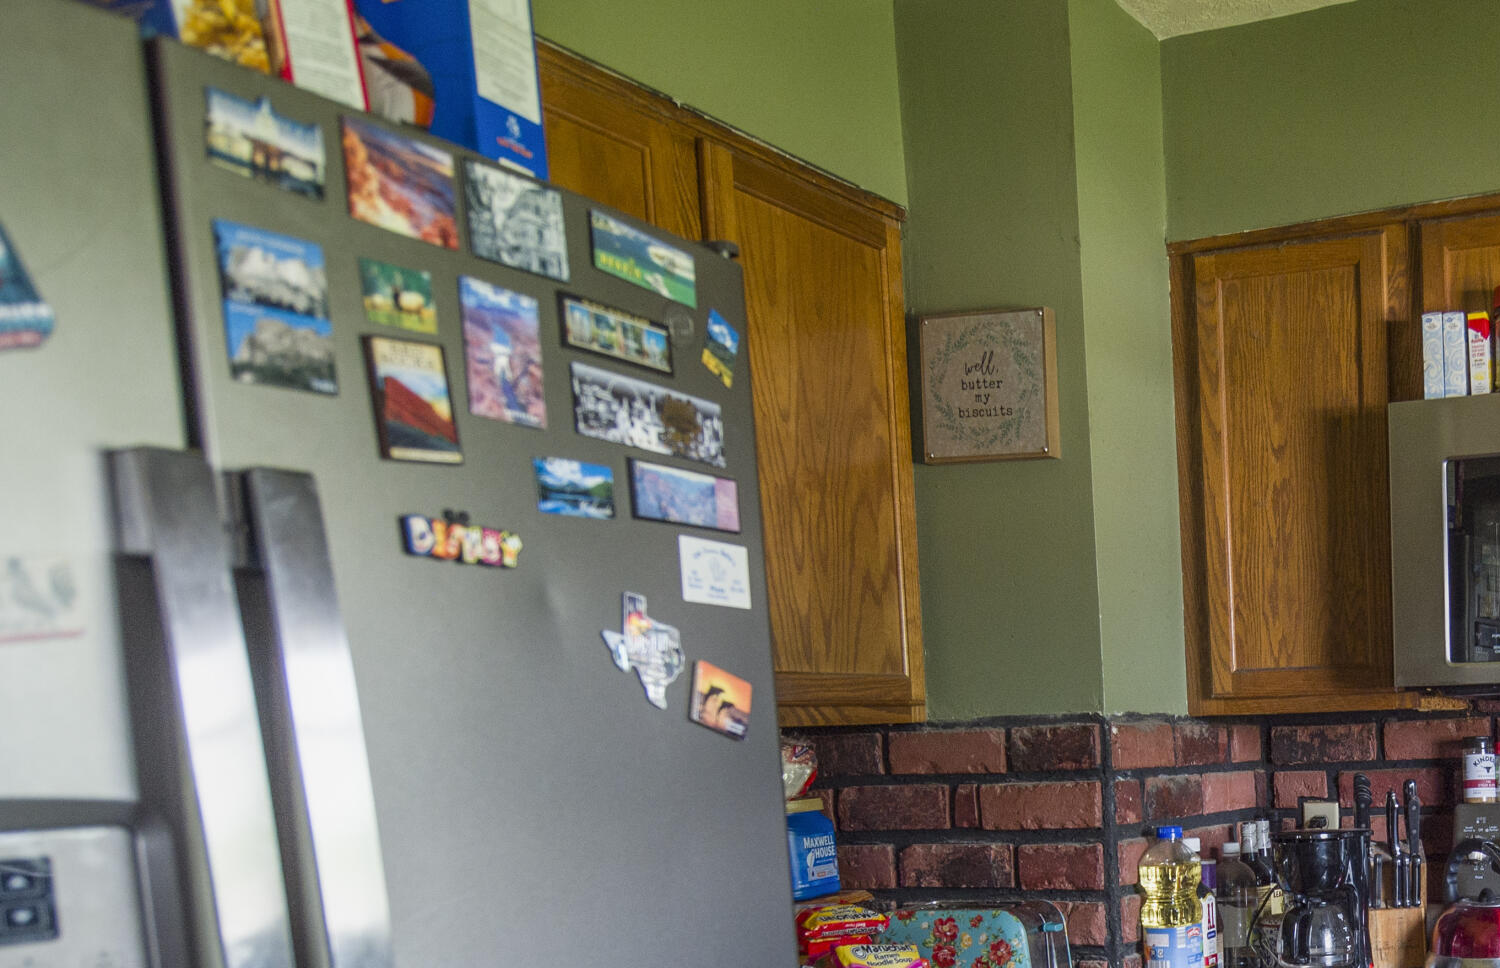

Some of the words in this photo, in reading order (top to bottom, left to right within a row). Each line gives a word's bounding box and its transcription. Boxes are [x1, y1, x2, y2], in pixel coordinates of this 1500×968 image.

[961, 378, 1003, 391] butter
[975, 393, 991, 405] my
[958, 406, 1014, 419] biscuits
[803, 835, 835, 849] MAXWELL
[815, 845, 836, 859] HOUSE
[861, 944, 913, 954] Maruchan
[867, 958, 894, 966] Noodle
[895, 957, 913, 965] Soup
